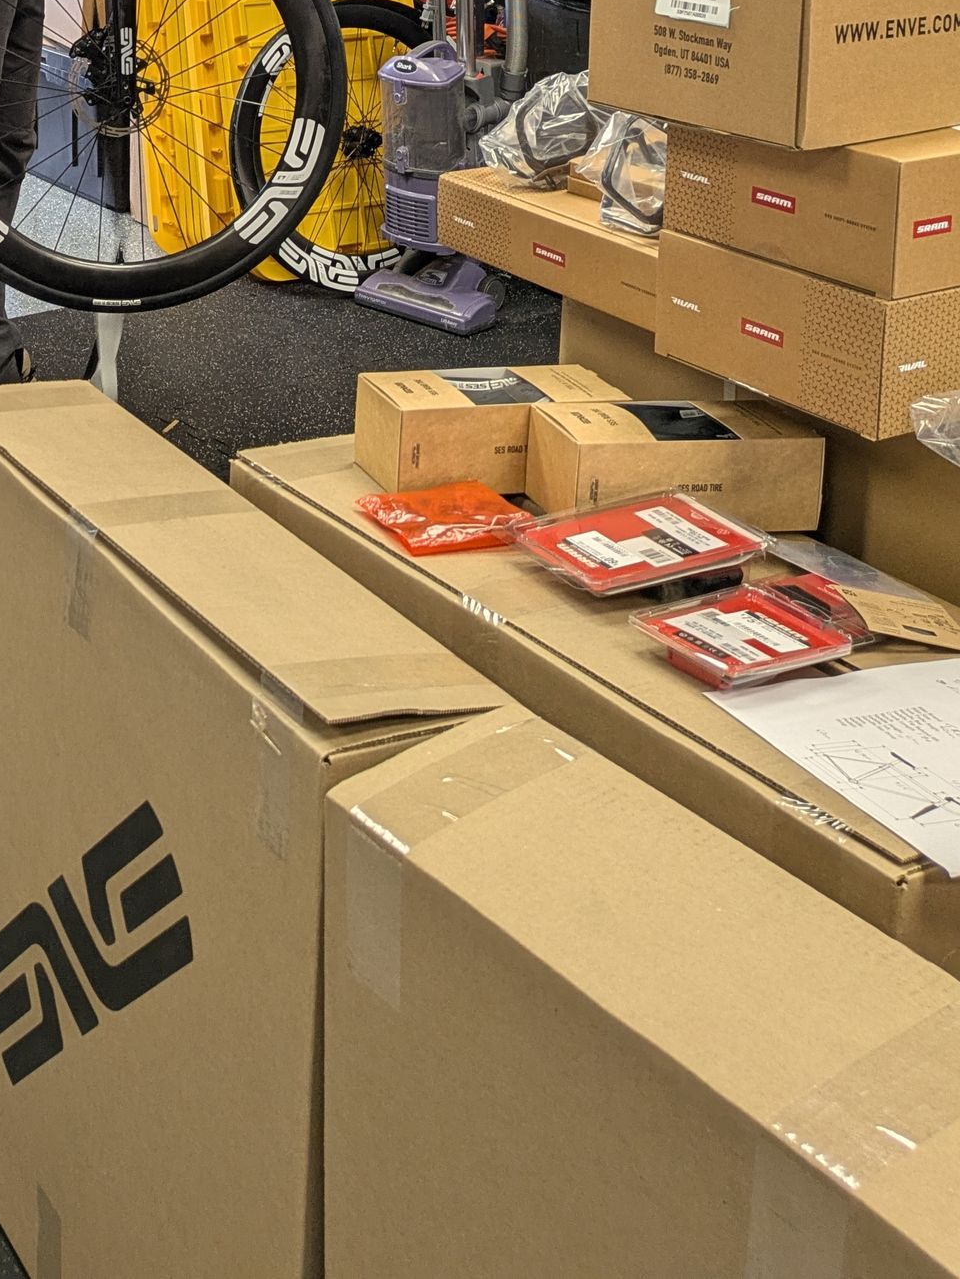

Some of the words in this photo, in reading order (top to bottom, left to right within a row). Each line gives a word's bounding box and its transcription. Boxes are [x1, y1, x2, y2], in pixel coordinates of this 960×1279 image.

[653, 24, 667, 38] 508
[668, 28, 677, 40] W.
[678, 30, 715, 48] Stockman
[716, 37, 733, 54] Way
[396, 61, 413, 72] Shark
[680, 48, 689, 61] UT
[691, 50, 713, 65] 84401
[714, 55, 730, 69] USA
[664, 62, 682, 78] (877)
[683, 66, 720, 85] 358-2869
[234, 117, 326, 245] ENVE
[680, 170, 711, 186] RIVAL
[755, 191, 793, 209] SRAM
[452, 215, 476, 229] RIVAL
[916, 220, 949, 235] SRAM
[535, 246, 564, 264] SRAM
[671, 296, 701, 313] RIVAL
[744, 323, 781, 342] SRAM
[898, 360, 928, 373] RIVAL
[494, 445, 506, 455] SES
[507, 444, 523, 454] ROAD
[691, 483, 709, 493] ROAD
[710, 483, 723, 492] TIRE
